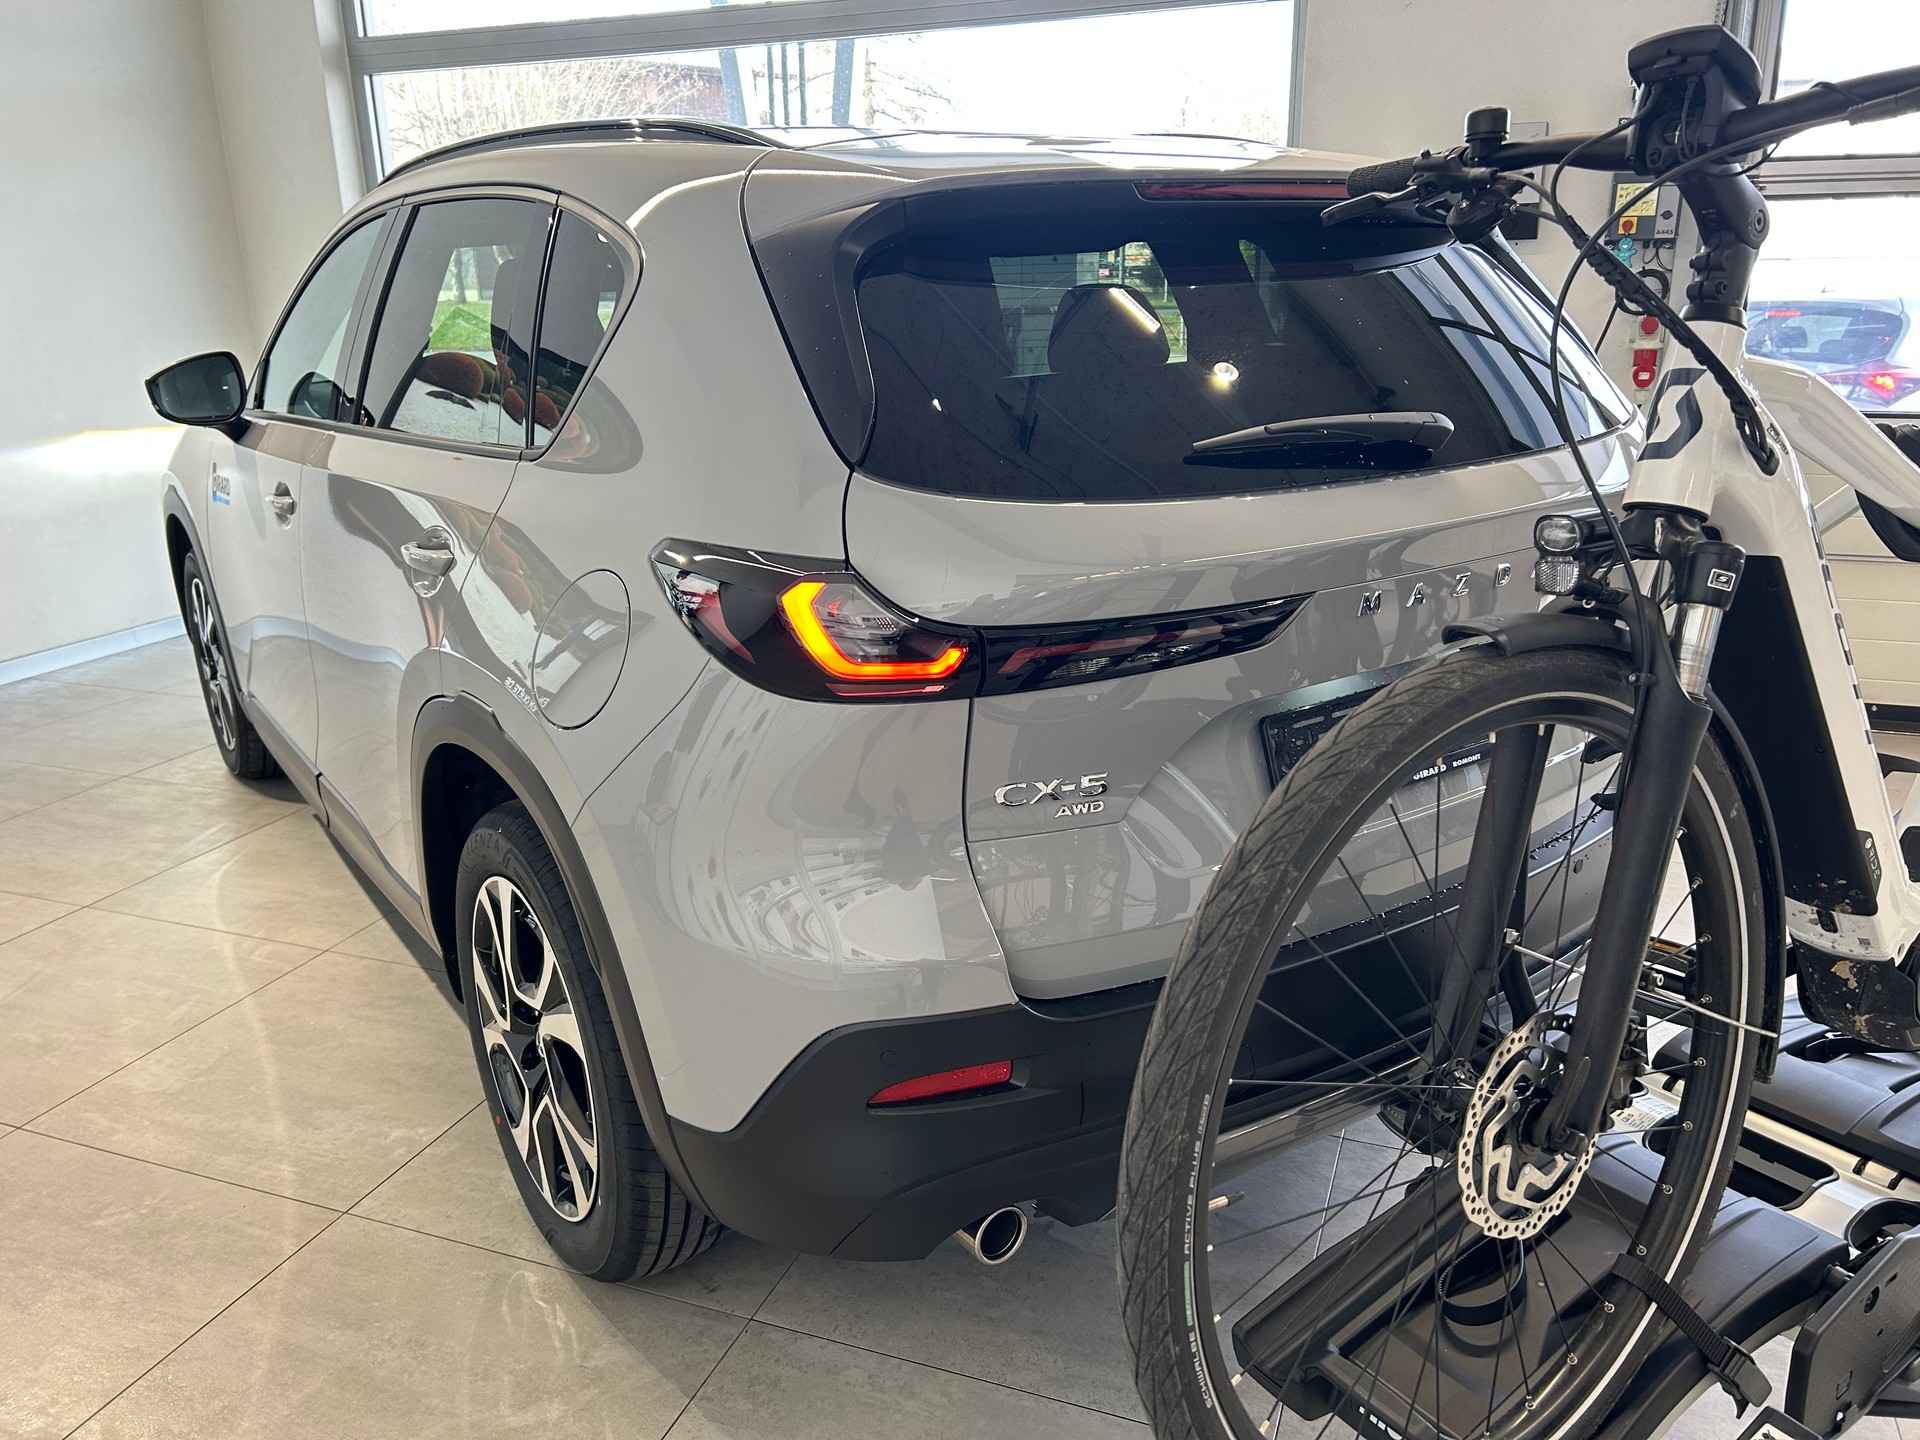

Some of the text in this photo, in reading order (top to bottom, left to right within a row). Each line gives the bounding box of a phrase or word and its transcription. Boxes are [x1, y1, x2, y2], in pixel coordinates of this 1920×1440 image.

[1357, 562, 1536, 618] MAZD
[1452, 753, 1482, 767] ROMONT
[994, 772, 1109, 806] CX-5
[1054, 800, 1105, 818] AWD
[1188, 1140, 1201, 1189] PLUS
[1184, 1194, 1193, 1255] ACTIVE
[1188, 1331, 1213, 1409] SCHWALBE
